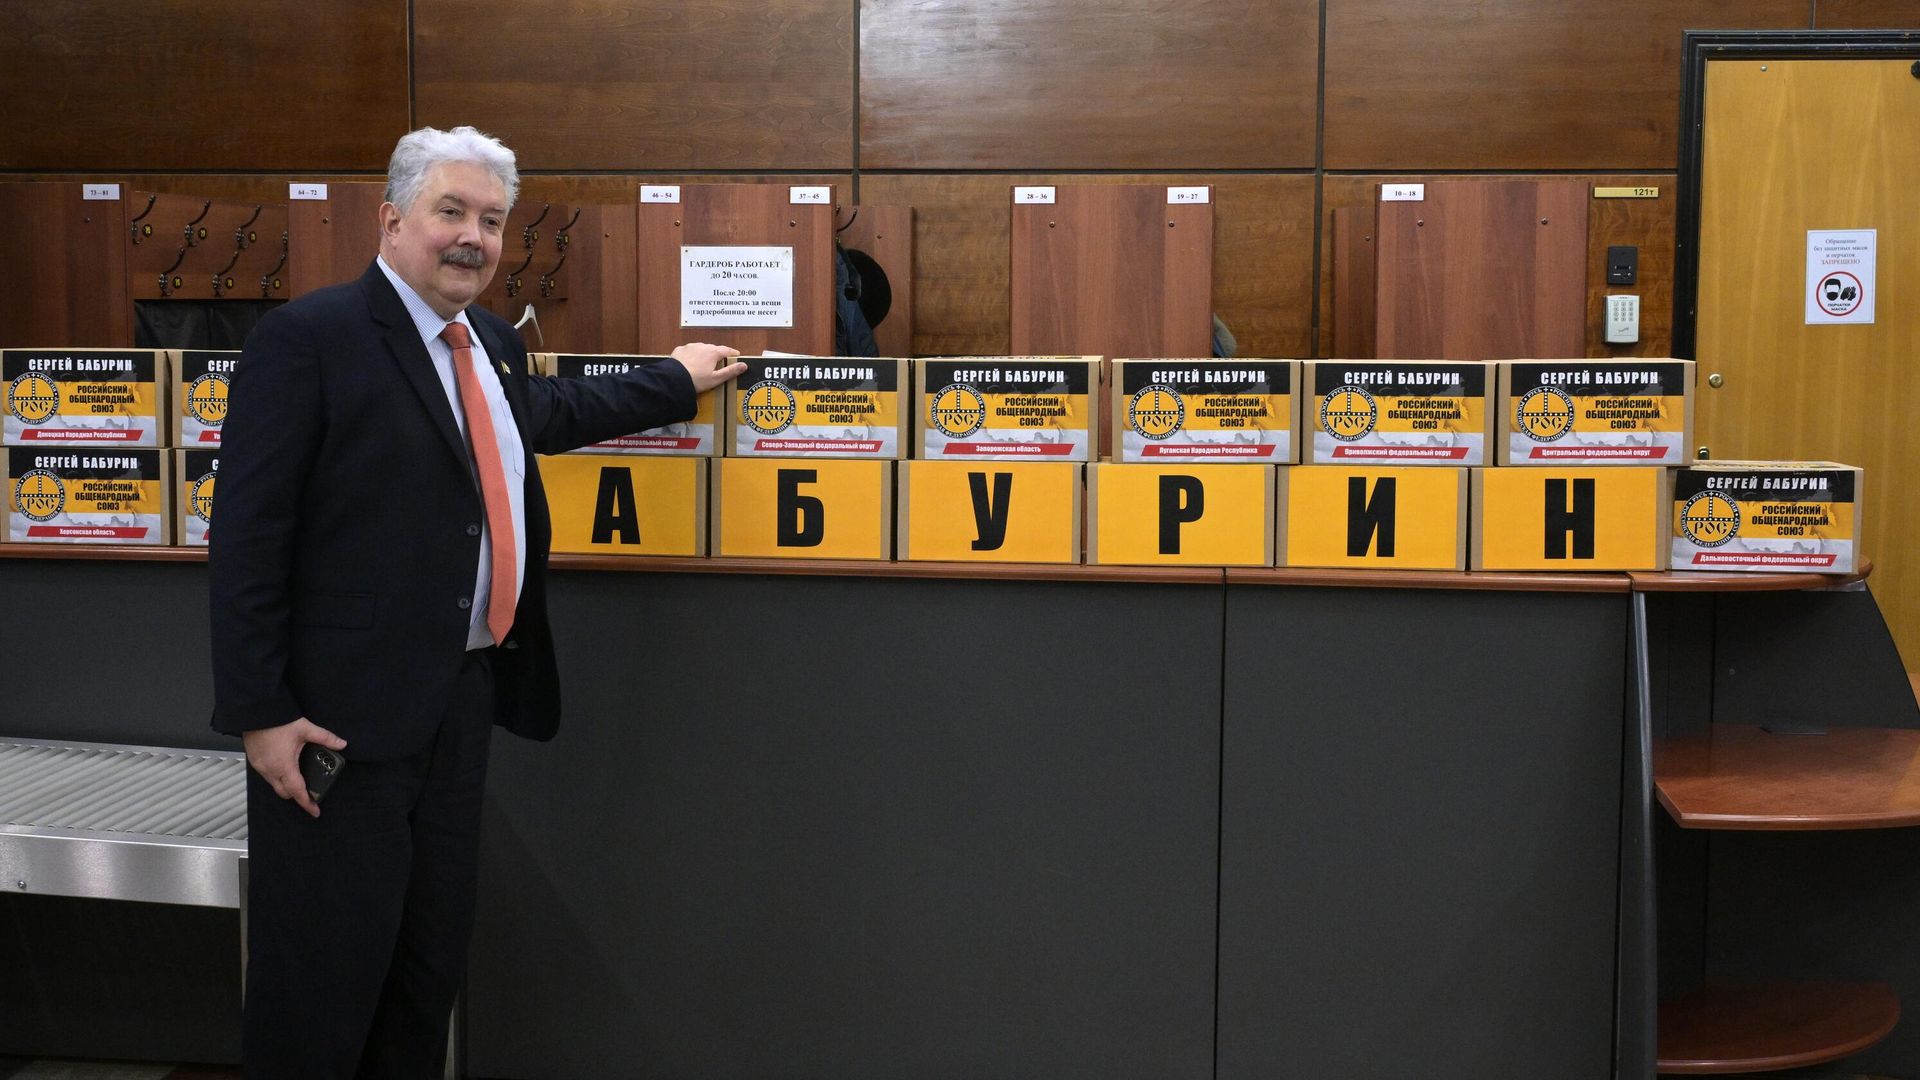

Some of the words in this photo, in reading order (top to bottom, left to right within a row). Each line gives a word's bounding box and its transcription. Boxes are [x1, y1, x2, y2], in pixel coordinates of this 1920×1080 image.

[689, 260, 733, 268] ГАРДЕРОБ
[722, 271, 732, 279] 20
[692, 308, 745, 316] гардеробщица
[29, 358, 73, 371] СЕРГЕЙ
[78, 359, 133, 371] БАБУРИН
[208, 360, 239, 372] СЕРГ
[584, 363, 629, 376] СЕРГЕЙ
[765, 365, 810, 379] СЕРГЕЙ
[815, 367, 873, 380] БАБУРИН
[954, 368, 1000, 382] СЕРГЕЙ
[1005, 370, 1065, 383] БАБУРИН
[1152, 369, 1200, 383] СЕРГЕЙ
[1205, 370, 1265, 383] БАБУРИН
[1344, 370, 1393, 384] СЕРГЕЙ
[1398, 372, 1460, 385] БАБУРИН
[1541, 370, 1590, 384] СЕРГЕЙ
[1595, 372, 1658, 384] БАБУРИН
[77, 384, 128, 394] РОССИЙСКИЙ
[69, 394, 135, 404] ОБЩЕНАРОДНЫЙ
[815, 393, 868, 403] РОССИЙСКИЙ
[1005, 397, 1059, 406] РОССИЙСКИЙ
[1205, 397, 1259, 407] РОССИЙСКИЙ
[806, 403, 875, 414] ОБЩЕНАРОДНЫЙ
[1398, 399, 1453, 409] РОССИЙСКИЙ
[1595, 399, 1652, 408] РОССИЙСКИЙ
[91, 405, 114, 413] СОЮЗ
[996, 406, 1066, 417] ОБЩЕНАРОДНЫЙ
[1196, 407, 1267, 417] ОБЩЕНАРОДНЫЙ
[1586, 408, 1660, 419] ОБЩЕНАРОДНЫЙ
[829, 415, 853, 423] СОЮЗ
[1388, 409, 1461, 420] ОБЩЕНАРОДНЫЙ
[1020, 418, 1044, 426] СОЮЗ
[1220, 419, 1245, 427] СОЮЗ
[1413, 420, 1437, 429] СОЮЗ
[1611, 420, 1636, 429] СОЮЗ
[761, 441, 814, 449] Северо-Западный
[815, 442, 858, 450] федеральный
[1586, 449, 1632, 457] федеральный
[35, 455, 78, 468] СЕРГЕЙ
[83, 456, 138, 469] БАБУРИН
[83, 481, 133, 492] РОССИЙСКИЙ
[1707, 476, 1758, 489] СЕРГЕЙ
[1763, 477, 1827, 490] БАБУРИН
[75, 492, 140, 502] ОБЩЕНАРОДНЫЙ
[97, 502, 119, 510] СОЮЗ
[1762, 505, 1820, 515] РОССИЙСКИЙ
[591, 467, 641, 544] А
[777, 469, 824, 547] Б
[968, 472, 1013, 551] У
[1158, 474, 1204, 555] Р
[1347, 477, 1397, 557] И
[1544, 478, 1595, 559] Н
[1752, 515, 1828, 526] ОБЩЕНАРОДНЫЙ
[1777, 527, 1804, 535] СОЮЗ
[1700, 554, 1760, 562] Дальневосточный
[1762, 556, 1809, 564] федеральный
